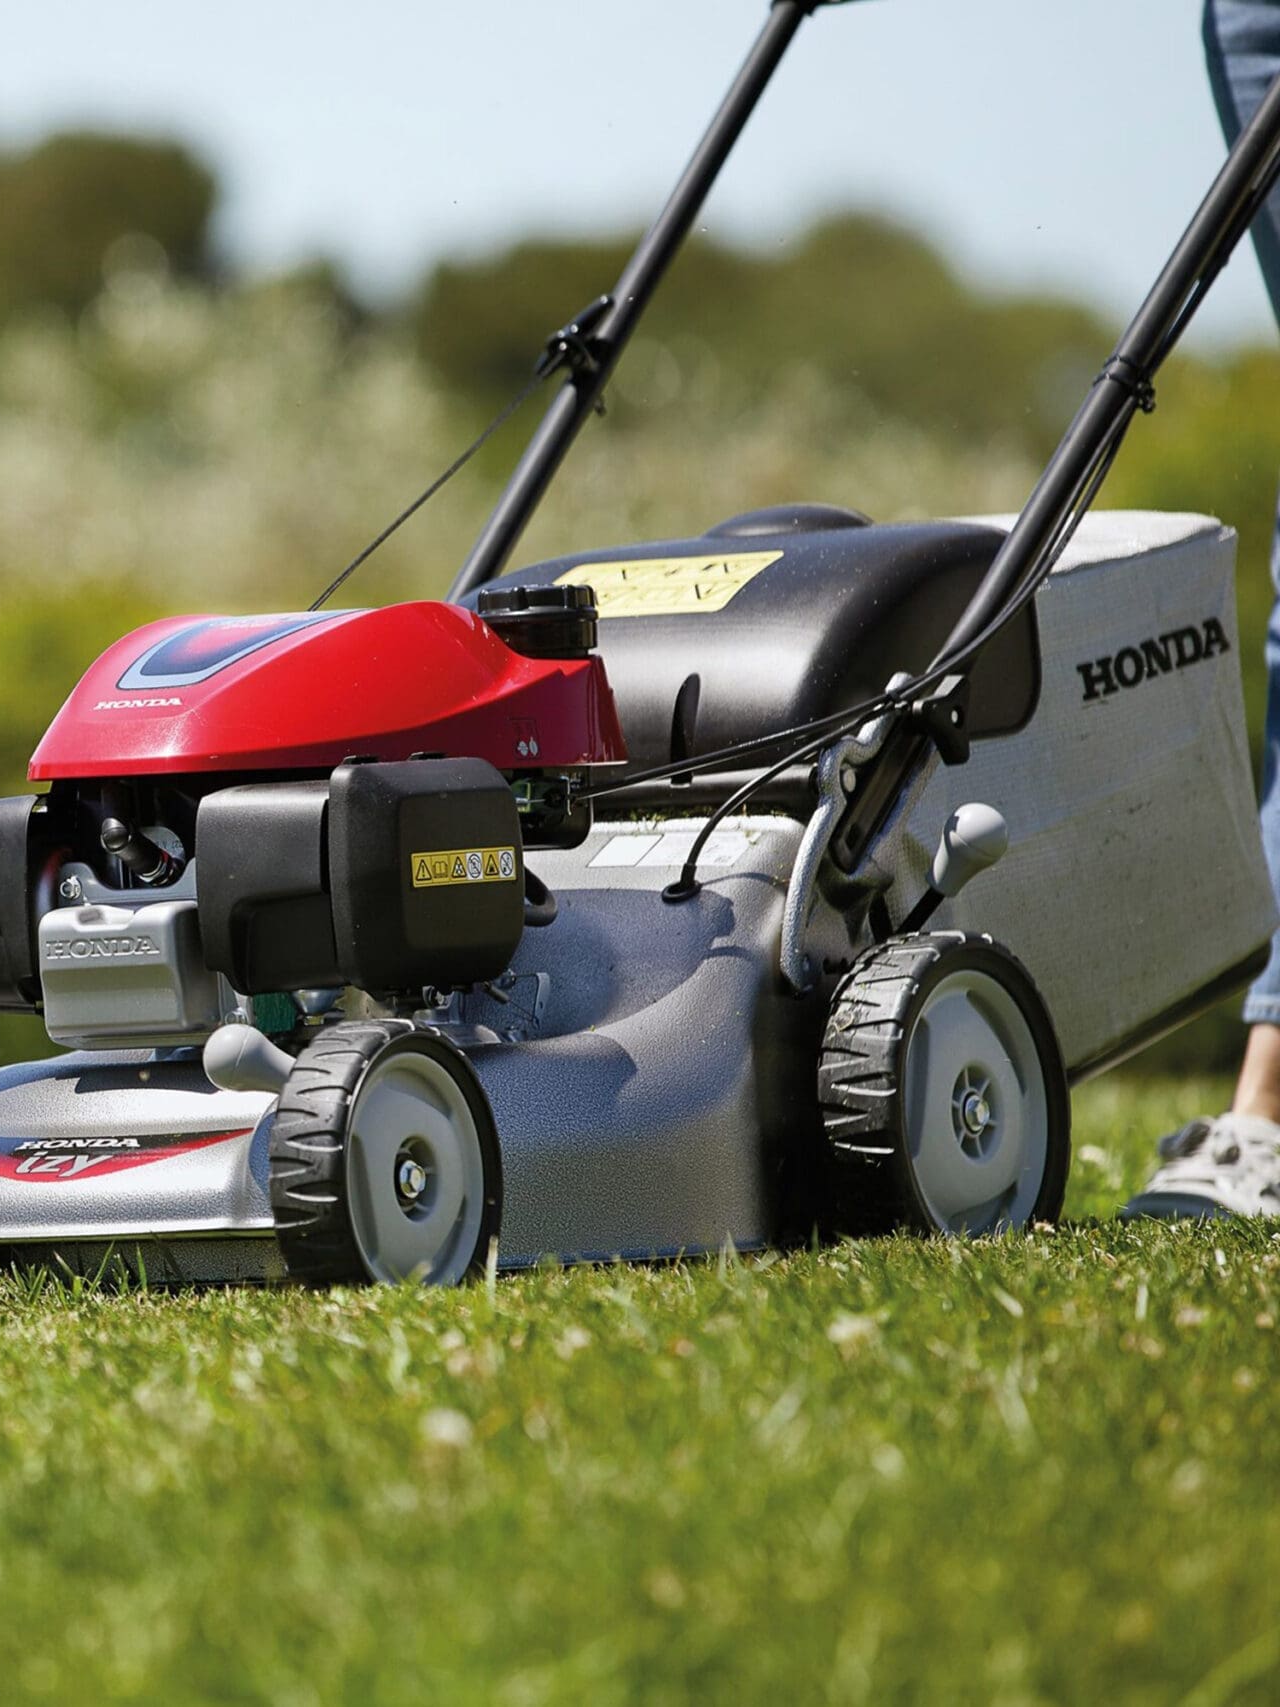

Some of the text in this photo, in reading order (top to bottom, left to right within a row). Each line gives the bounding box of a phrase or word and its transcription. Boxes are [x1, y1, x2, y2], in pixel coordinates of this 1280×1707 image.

[1076, 616, 1231, 700] HONDA
[93, 697, 183, 711] HONDA
[45, 935, 160, 959] HONDA
[15, 1138, 140, 1151] HONDA
[16, 1151, 114, 1177] izy
